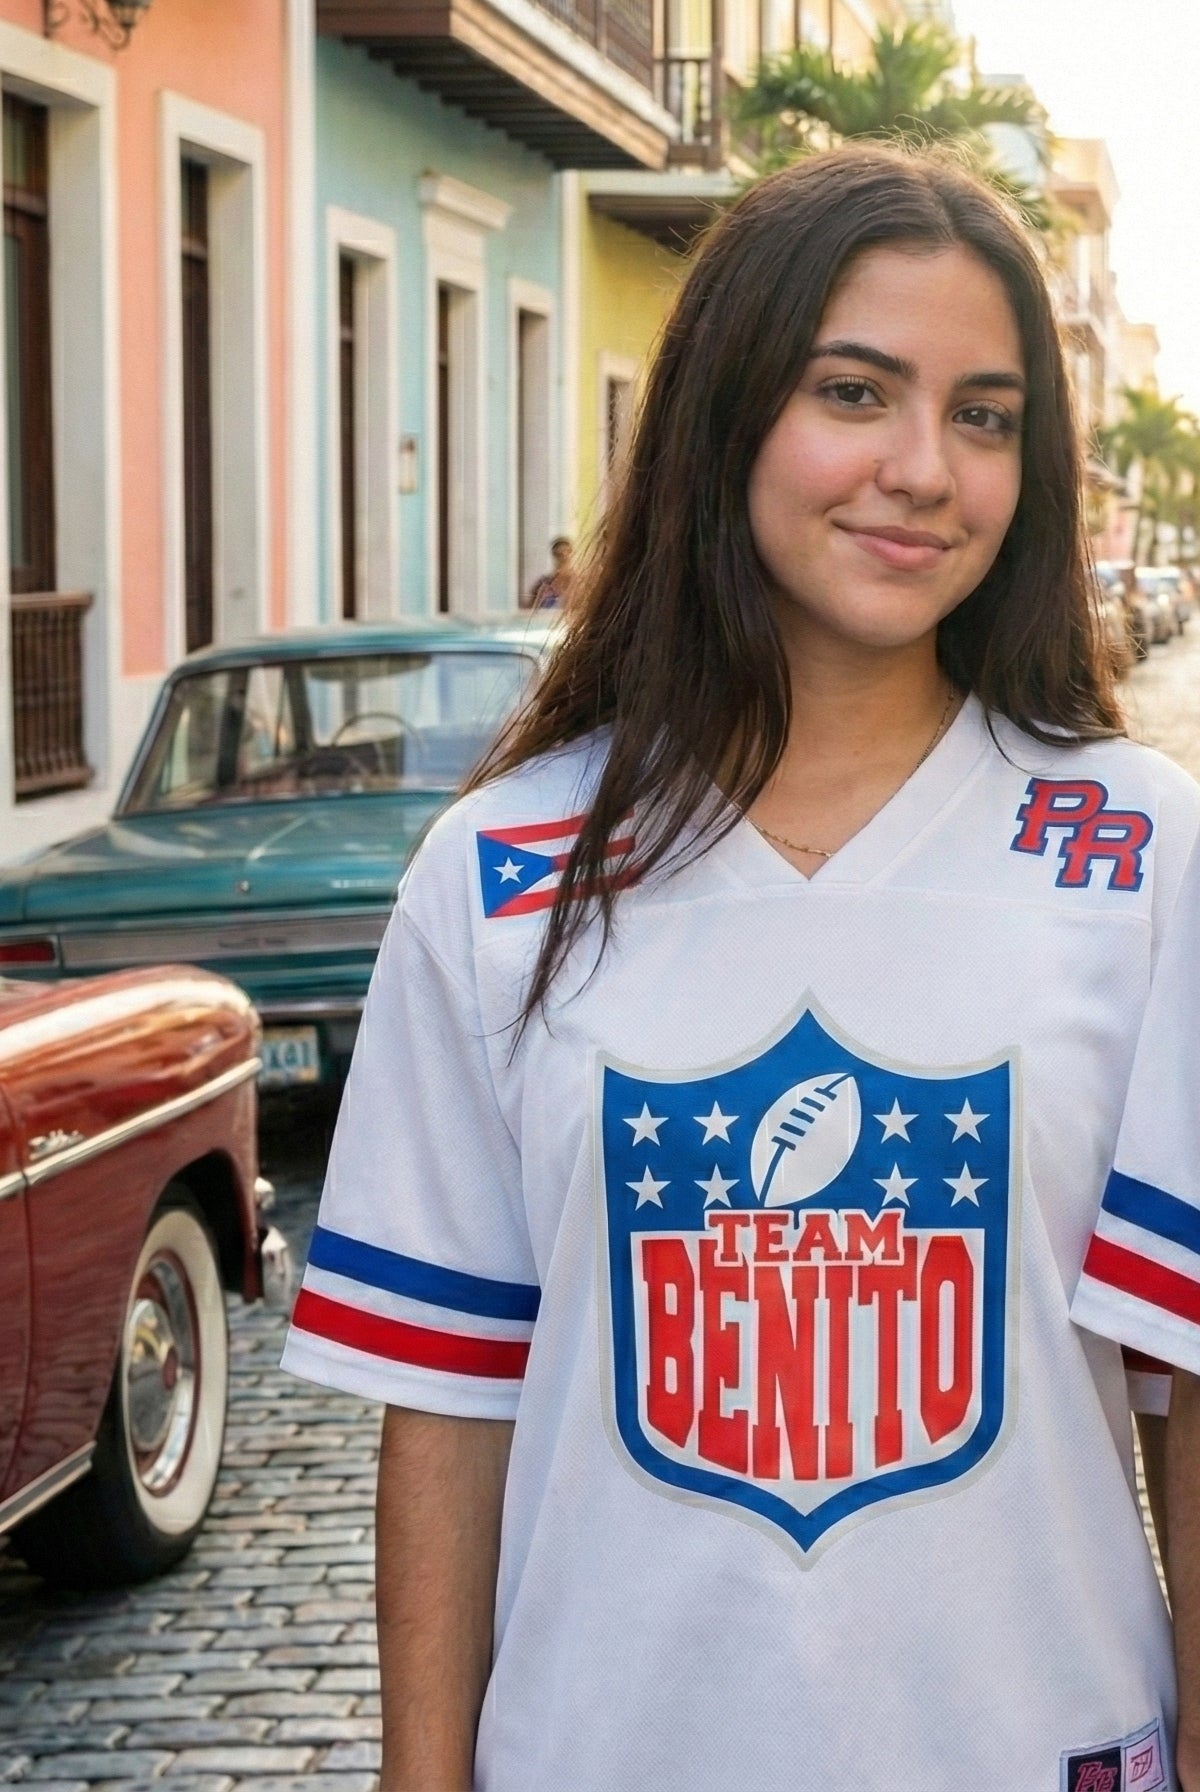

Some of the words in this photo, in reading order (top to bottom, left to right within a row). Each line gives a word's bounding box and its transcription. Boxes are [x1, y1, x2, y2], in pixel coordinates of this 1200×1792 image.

[1009, 777, 1154, 893] PR
[706, 1212, 904, 1264] TEAM
[641, 1235, 974, 1480] BENITO
